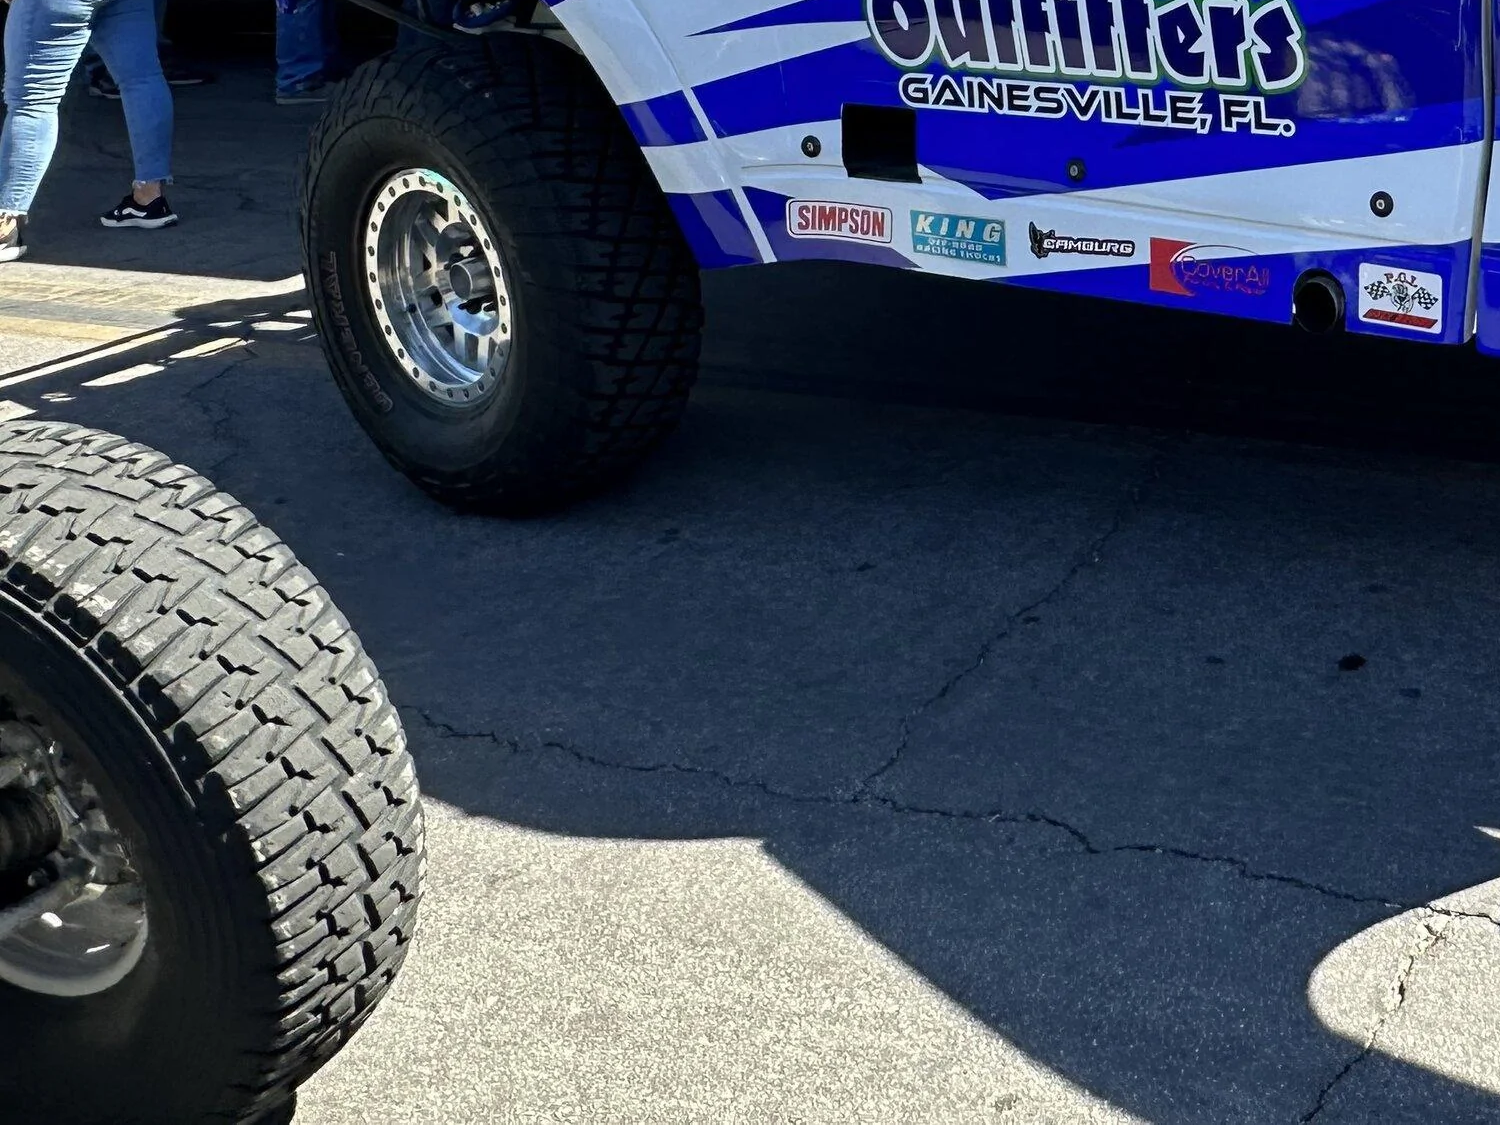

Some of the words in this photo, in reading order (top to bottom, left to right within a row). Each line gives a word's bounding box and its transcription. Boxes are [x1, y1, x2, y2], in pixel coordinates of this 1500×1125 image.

[899, 73, 1211, 134] GAINESVILLE,
[1219, 94, 1296, 137] FL.
[797, 205, 886, 238] SIMPSON
[916, 214, 1002, 243] KING
